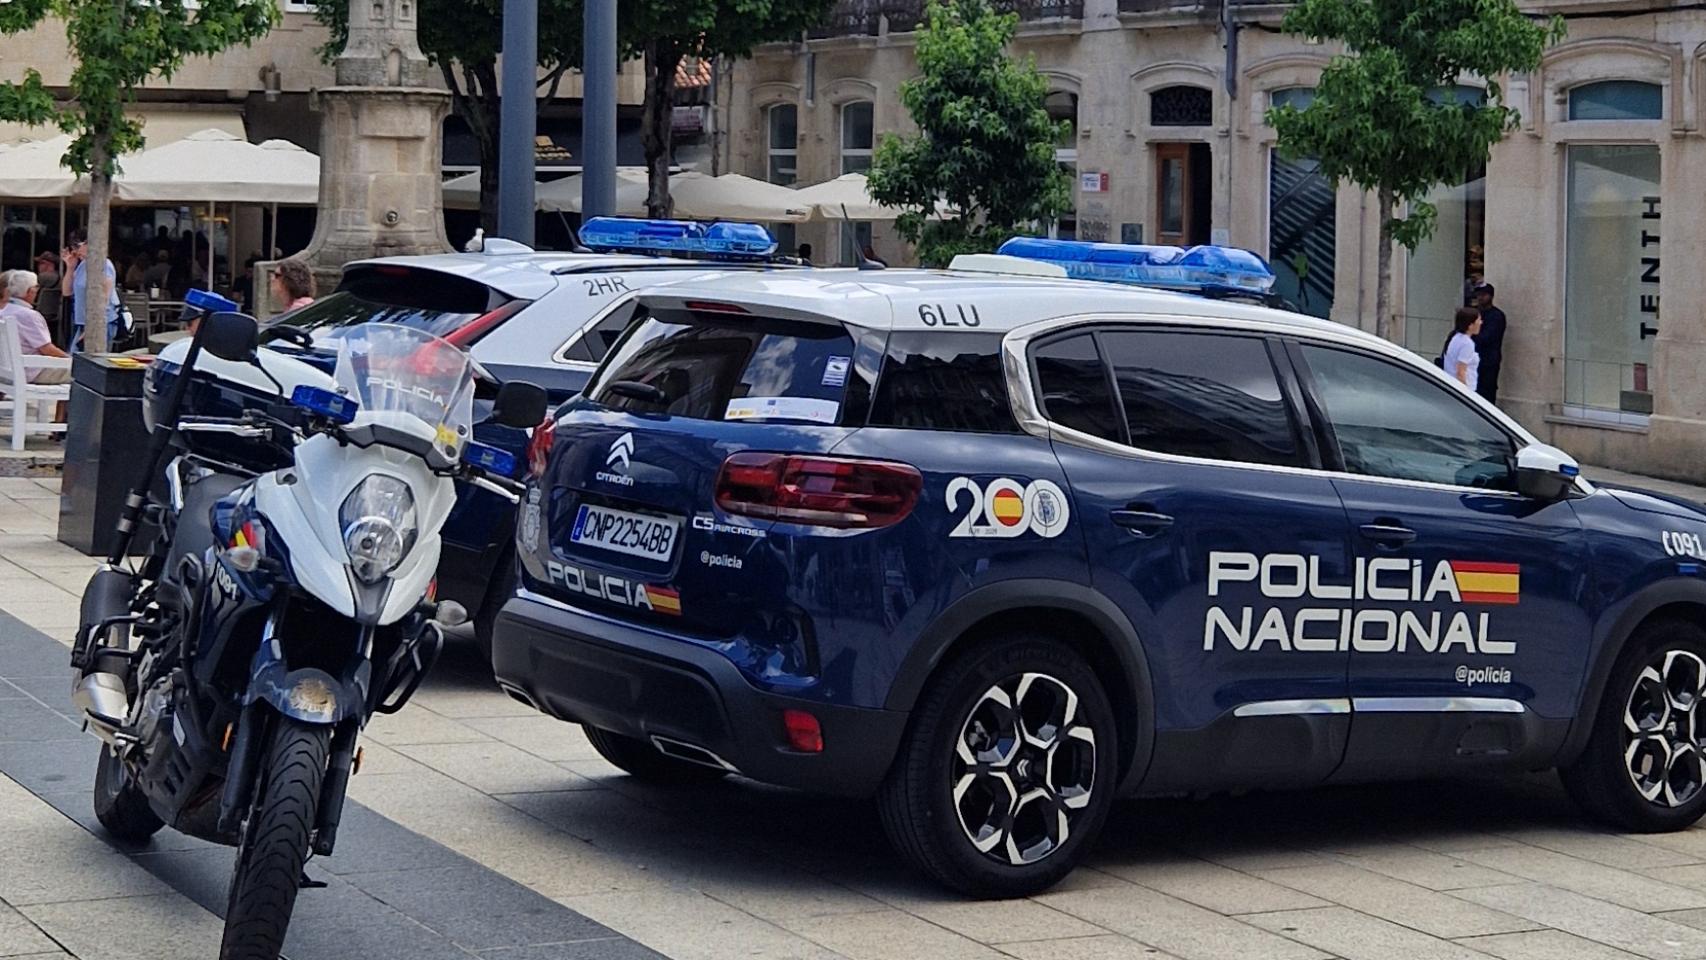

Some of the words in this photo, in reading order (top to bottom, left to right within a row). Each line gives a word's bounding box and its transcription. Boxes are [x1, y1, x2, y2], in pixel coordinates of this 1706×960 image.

[1640, 196, 1661, 340] TENTH
[582, 275, 631, 297] 2HR
[918, 303, 981, 328] 6LU
[366, 376, 444, 407] POLICIA
[945, 476, 1070, 538] 200
[582, 510, 674, 556] CNP2254BB
[692, 515, 714, 531] C5
[714, 523, 767, 538] AIRCROSS
[700, 550, 743, 569] @policia
[218, 566, 237, 600] 091
[547, 560, 654, 611] POLICIA
[1203, 606, 1517, 654] NACIONAL
